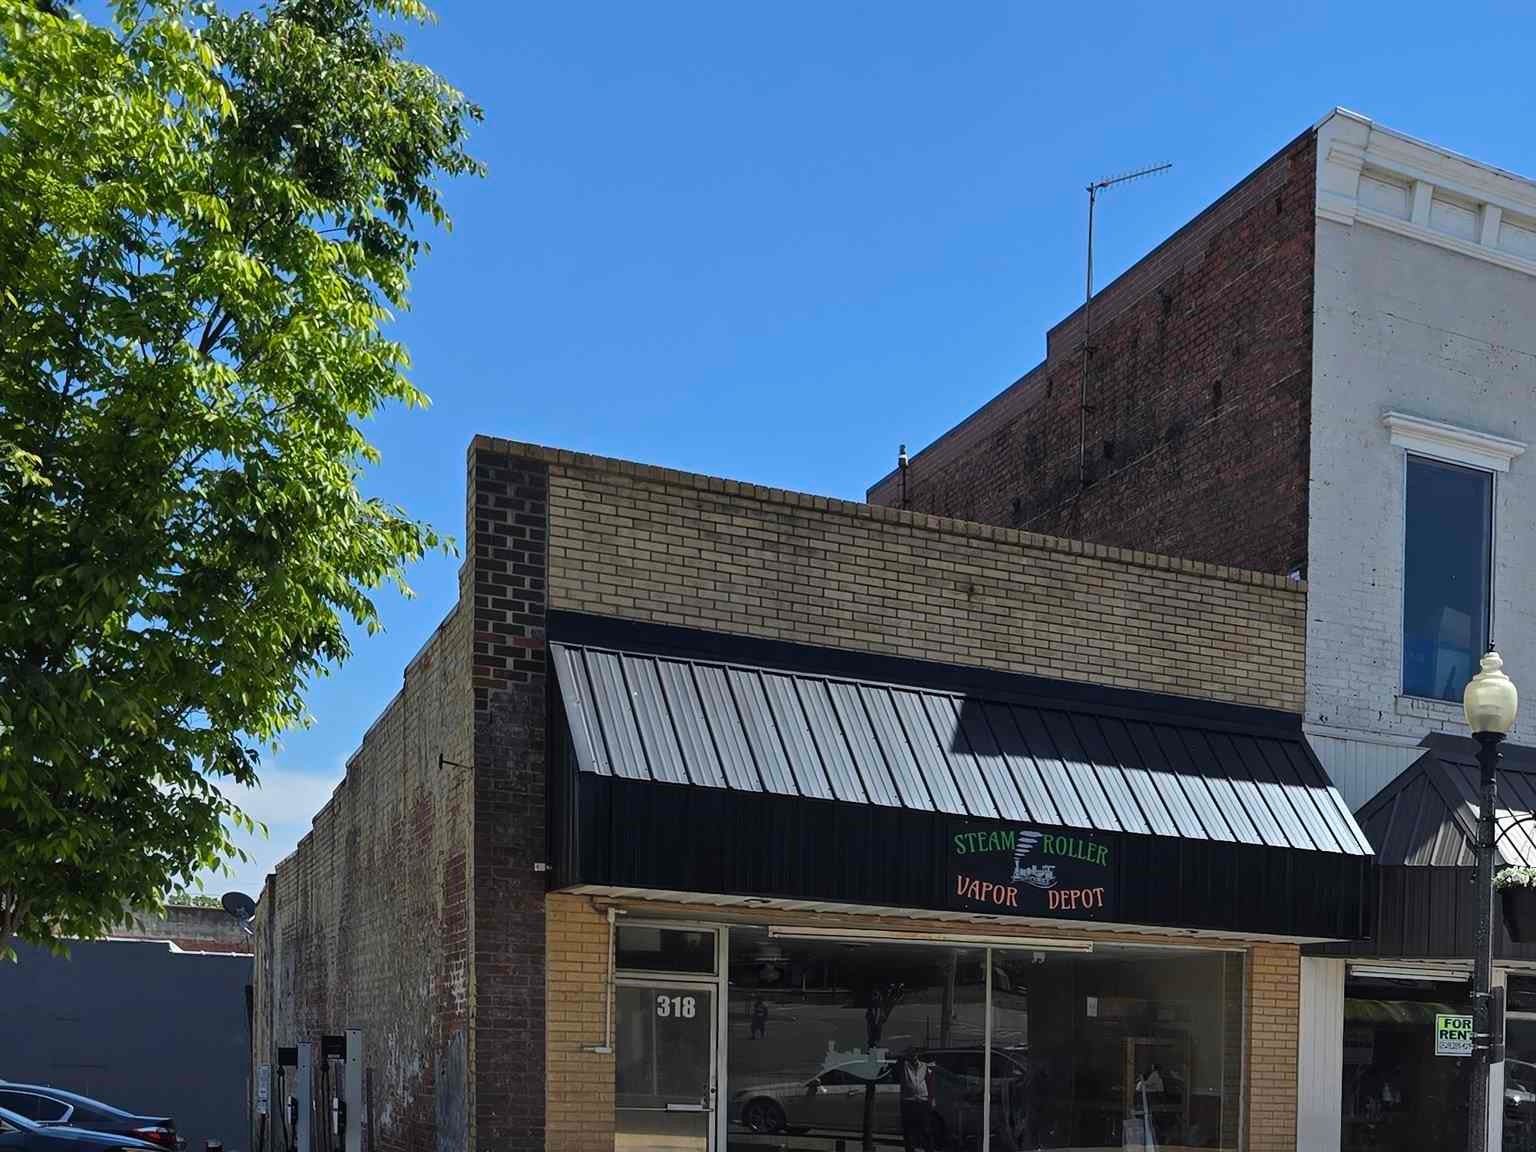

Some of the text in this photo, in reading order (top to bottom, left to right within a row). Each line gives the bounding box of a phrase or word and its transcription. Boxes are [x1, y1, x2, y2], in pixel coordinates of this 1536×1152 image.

[954, 830, 1109, 867] STEAM ROLLER
[956, 875, 1105, 910] VAPOR DEPOT
[656, 995, 696, 1018] 318
[1444, 1018, 1472, 1029] FOR
